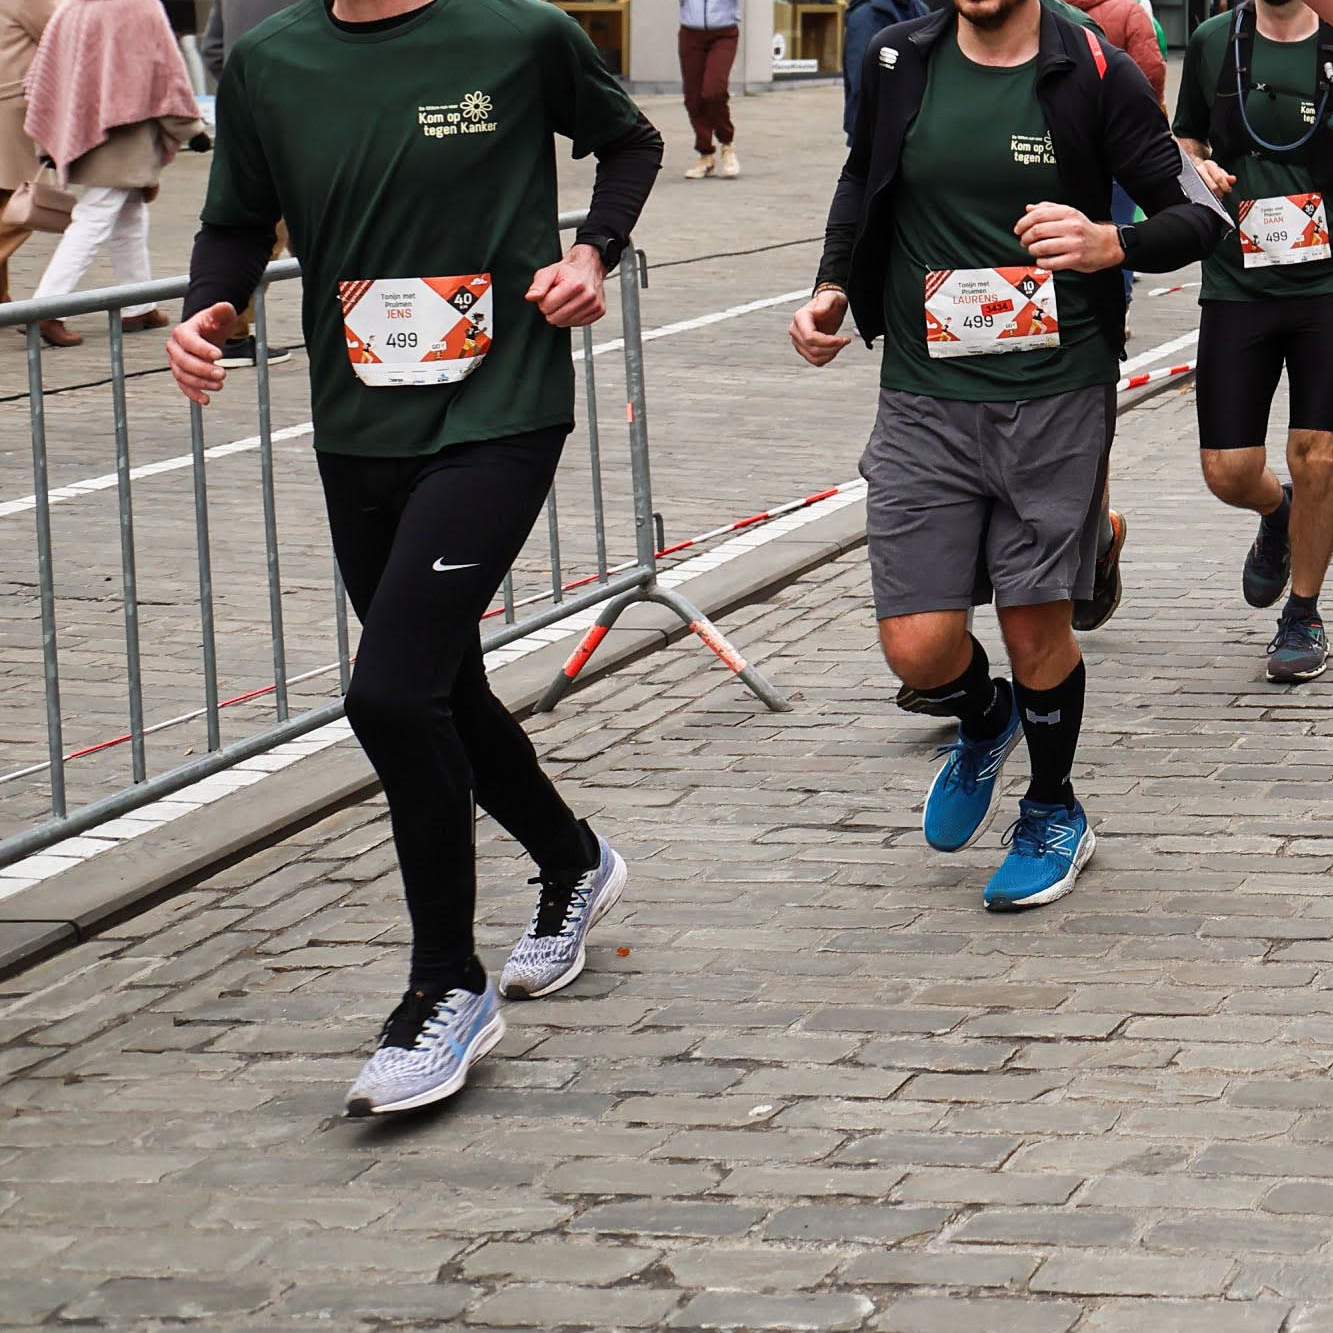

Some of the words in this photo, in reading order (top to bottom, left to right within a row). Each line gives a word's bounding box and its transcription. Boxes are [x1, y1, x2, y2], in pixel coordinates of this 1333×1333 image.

[1300, 105, 1315, 114] Kom
[418, 112, 444, 124] Kom
[447, 112, 461, 124] op
[424, 125, 457, 138] tegen
[460, 120, 498, 134] Kanker
[1011, 140, 1031, 151] Kom
[1033, 144, 1044, 155] op
[1014, 151, 1041, 165] tegen
[1266, 231, 1288, 242] 499
[1022, 281, 1035, 291] 10
[453, 293, 472, 305] 40
[952, 293, 999, 305] LAURENS
[386, 309, 412, 319] JENS
[963, 314, 995, 329] 499
[386, 332, 418, 348] 499
